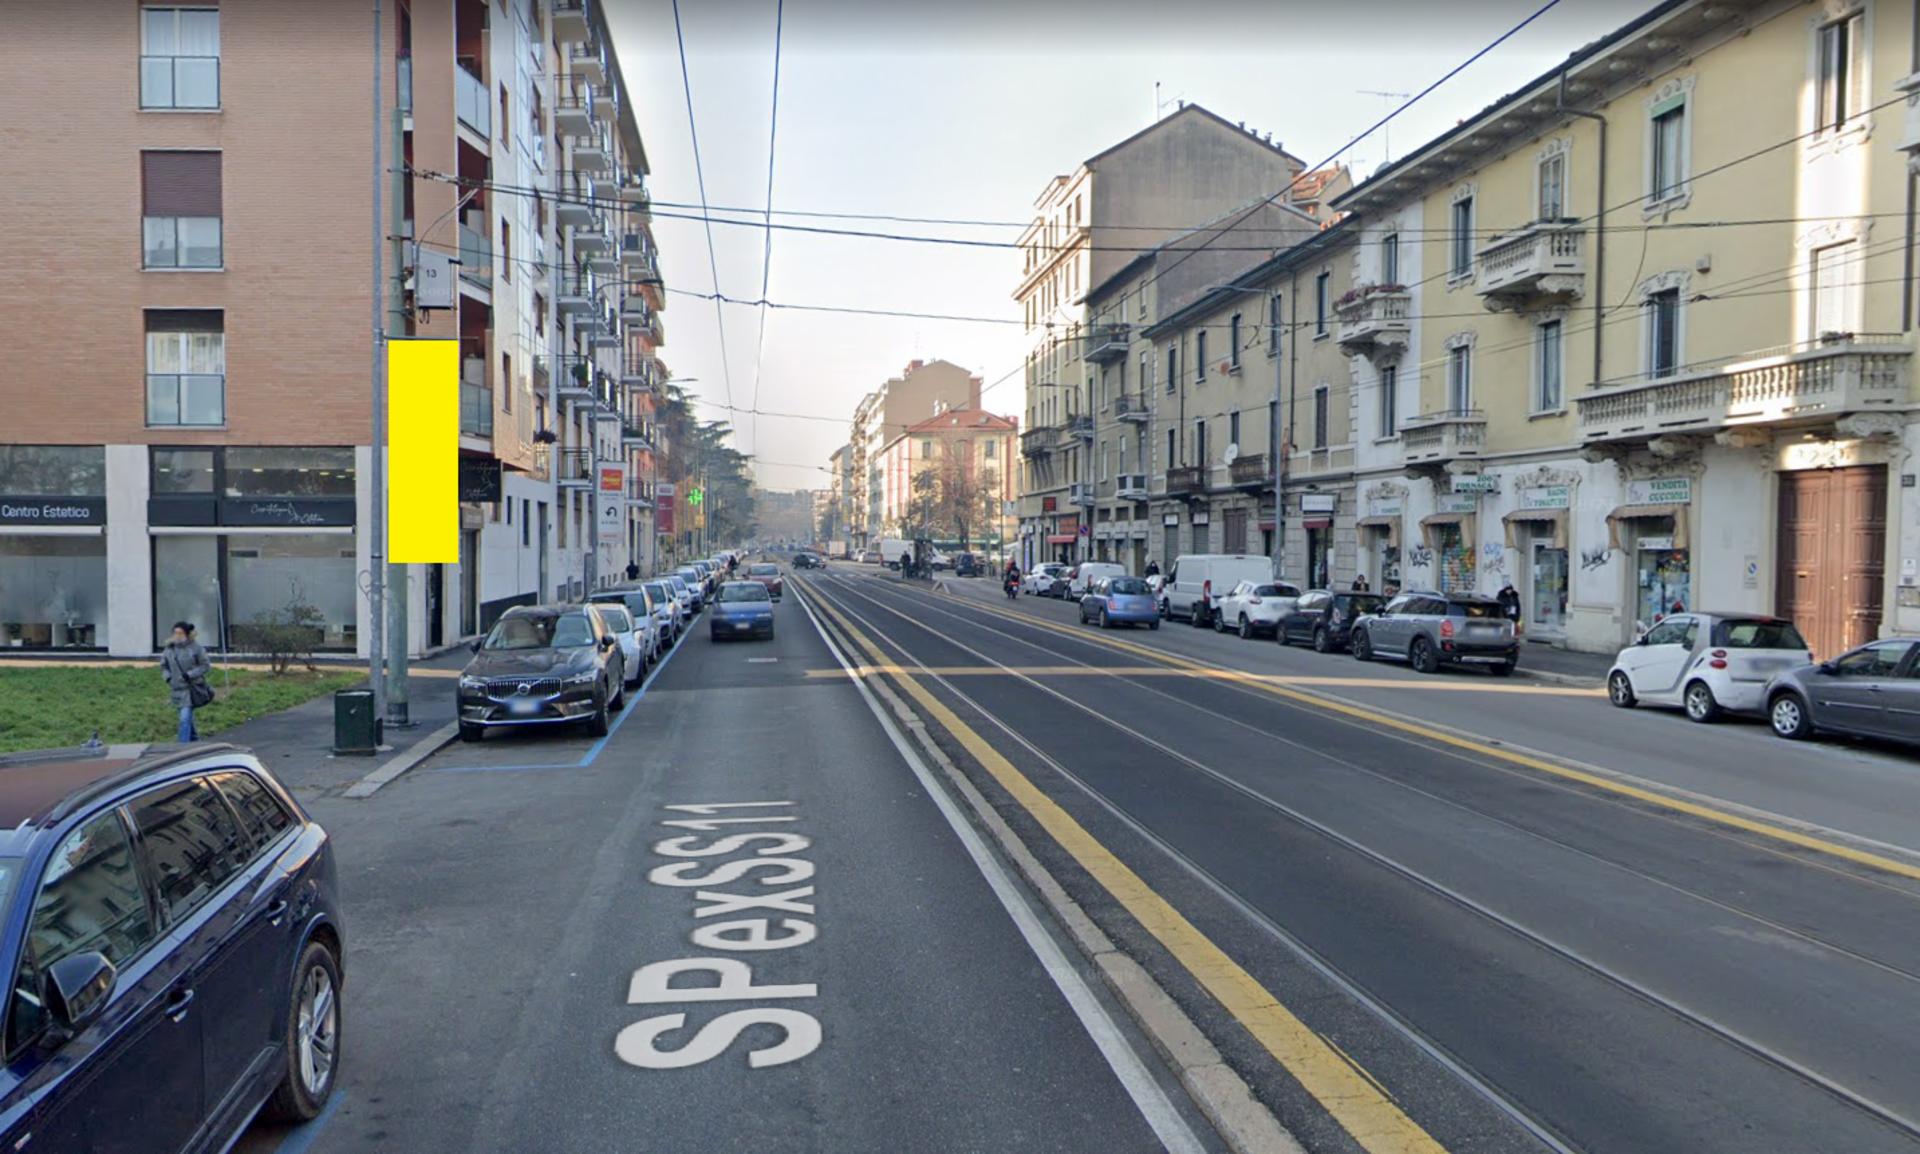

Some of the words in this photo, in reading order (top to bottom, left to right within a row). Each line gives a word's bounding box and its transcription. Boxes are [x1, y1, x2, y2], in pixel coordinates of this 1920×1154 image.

[426, 269, 438, 278] 13
[1650, 479, 1688, 490] VENDITA
[1, 504, 40, 518] Centro
[43, 505, 90, 518] Estetico
[614, 801, 823, 1070] SPexSS11
